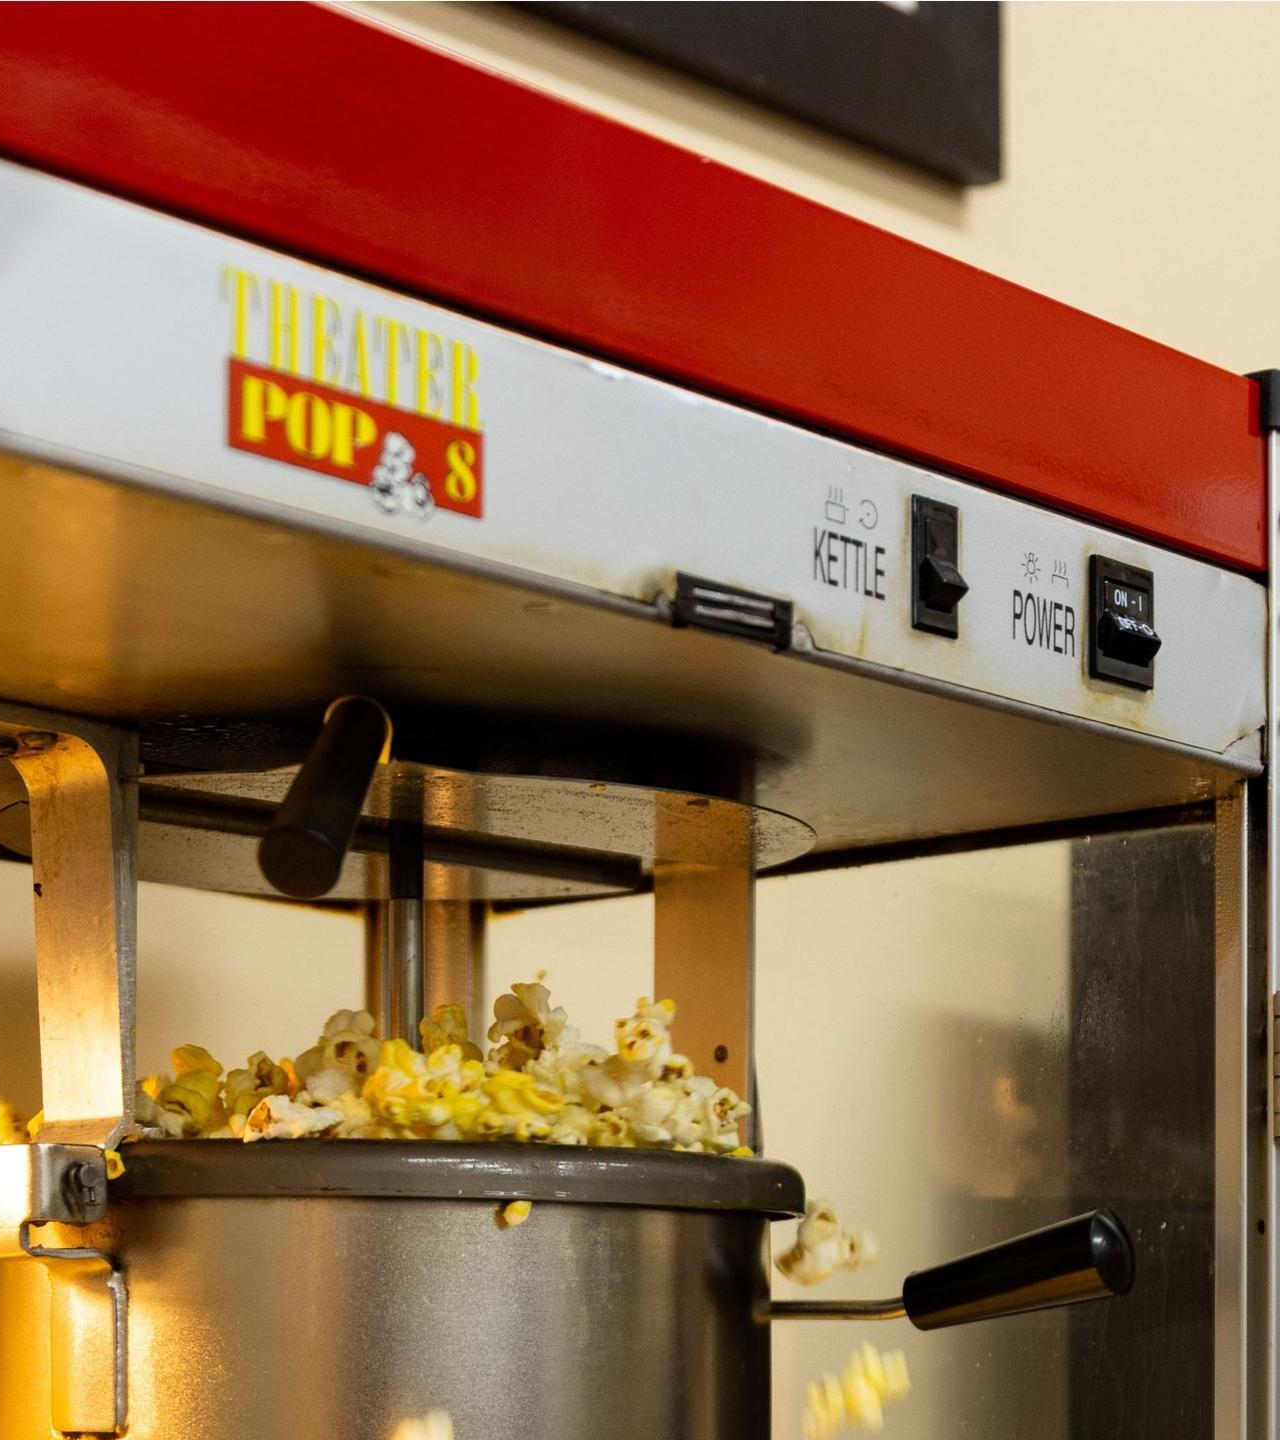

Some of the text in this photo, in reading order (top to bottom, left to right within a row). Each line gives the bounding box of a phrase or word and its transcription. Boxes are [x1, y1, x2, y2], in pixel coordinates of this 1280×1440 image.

[222, 267, 480, 429] THEATER
[243, 377, 475, 501] POP 8
[813, 528, 885, 600] KETTLE
[1114, 589, 1128, 607] ON
[1013, 590, 1075, 657] POWER
